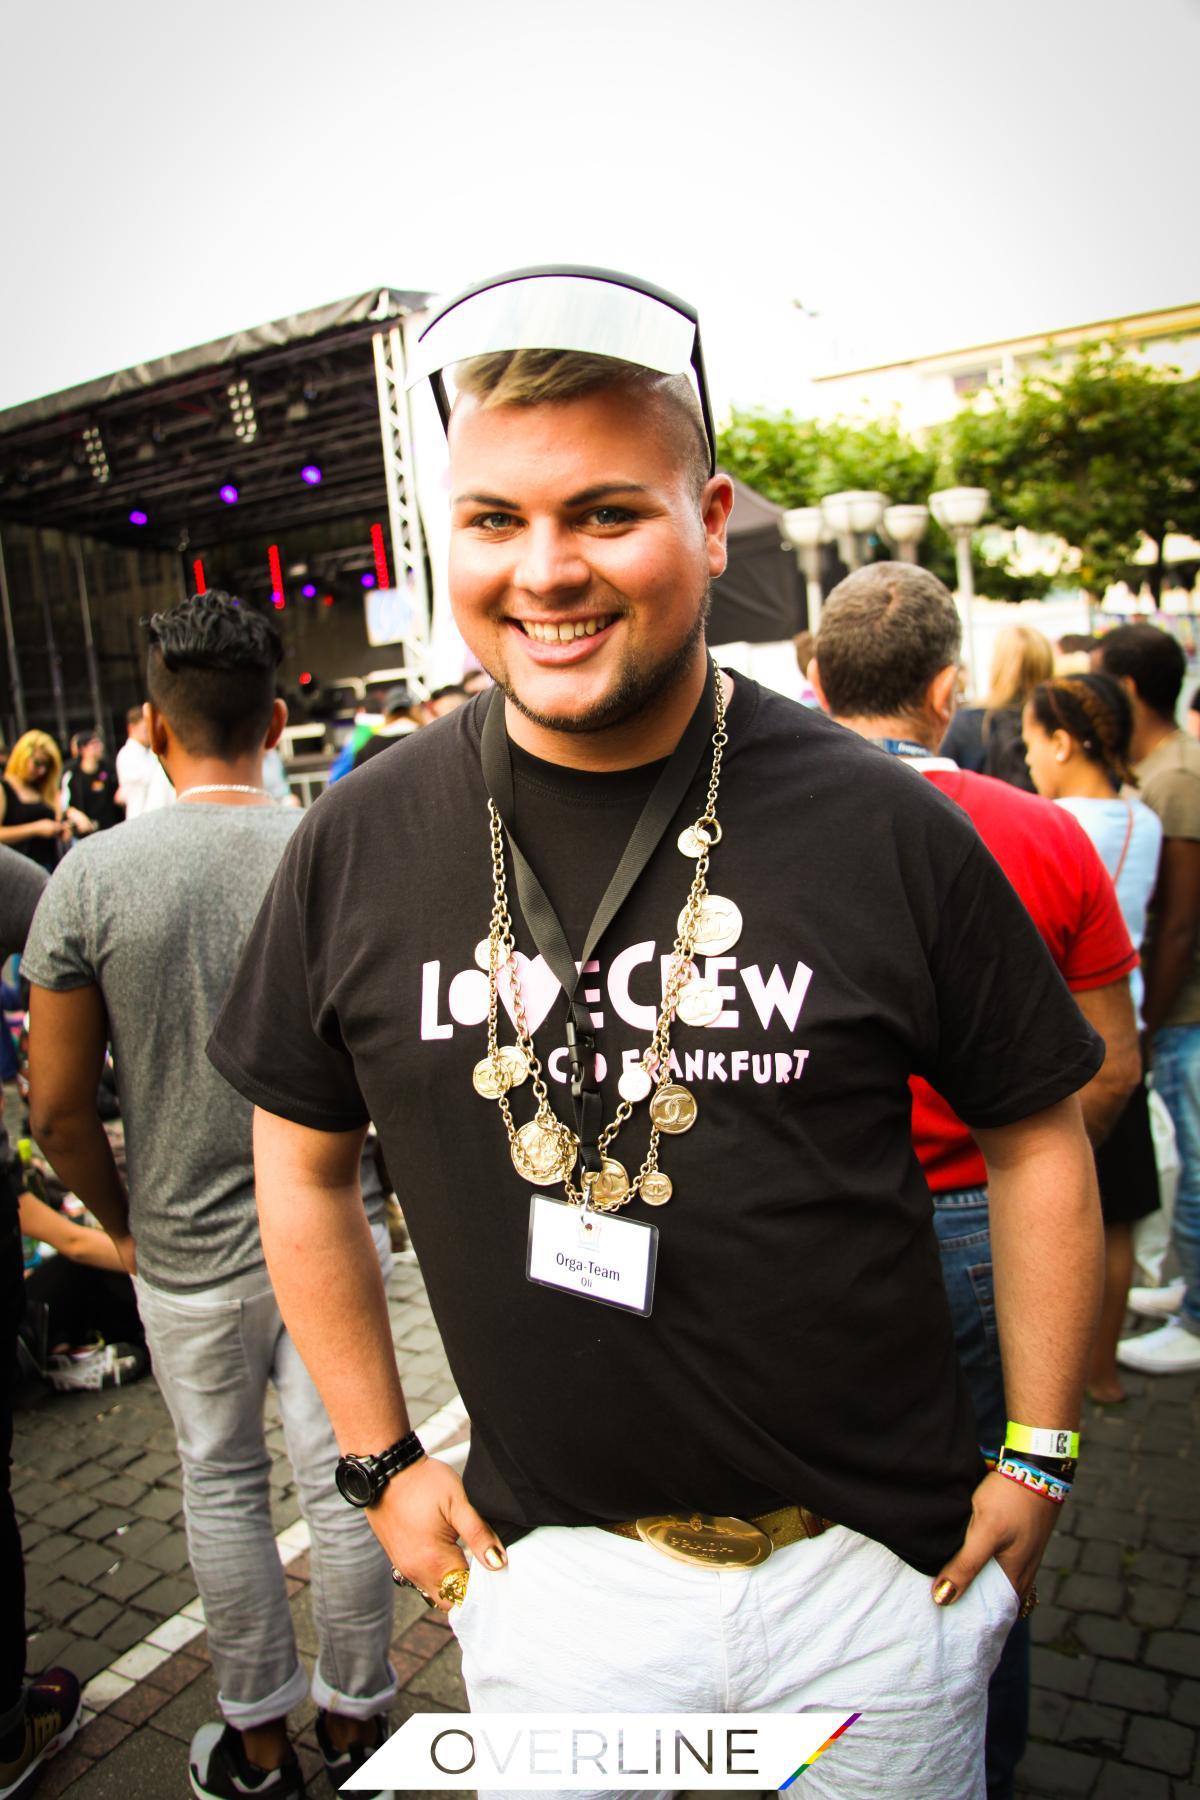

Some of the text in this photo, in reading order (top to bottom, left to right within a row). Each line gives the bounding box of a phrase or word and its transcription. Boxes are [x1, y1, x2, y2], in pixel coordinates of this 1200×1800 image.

[547, 1047, 607, 1084] CD
[556, 1252, 620, 1281] Orga-Team
[580, 1277, 593, 1288] Oli
